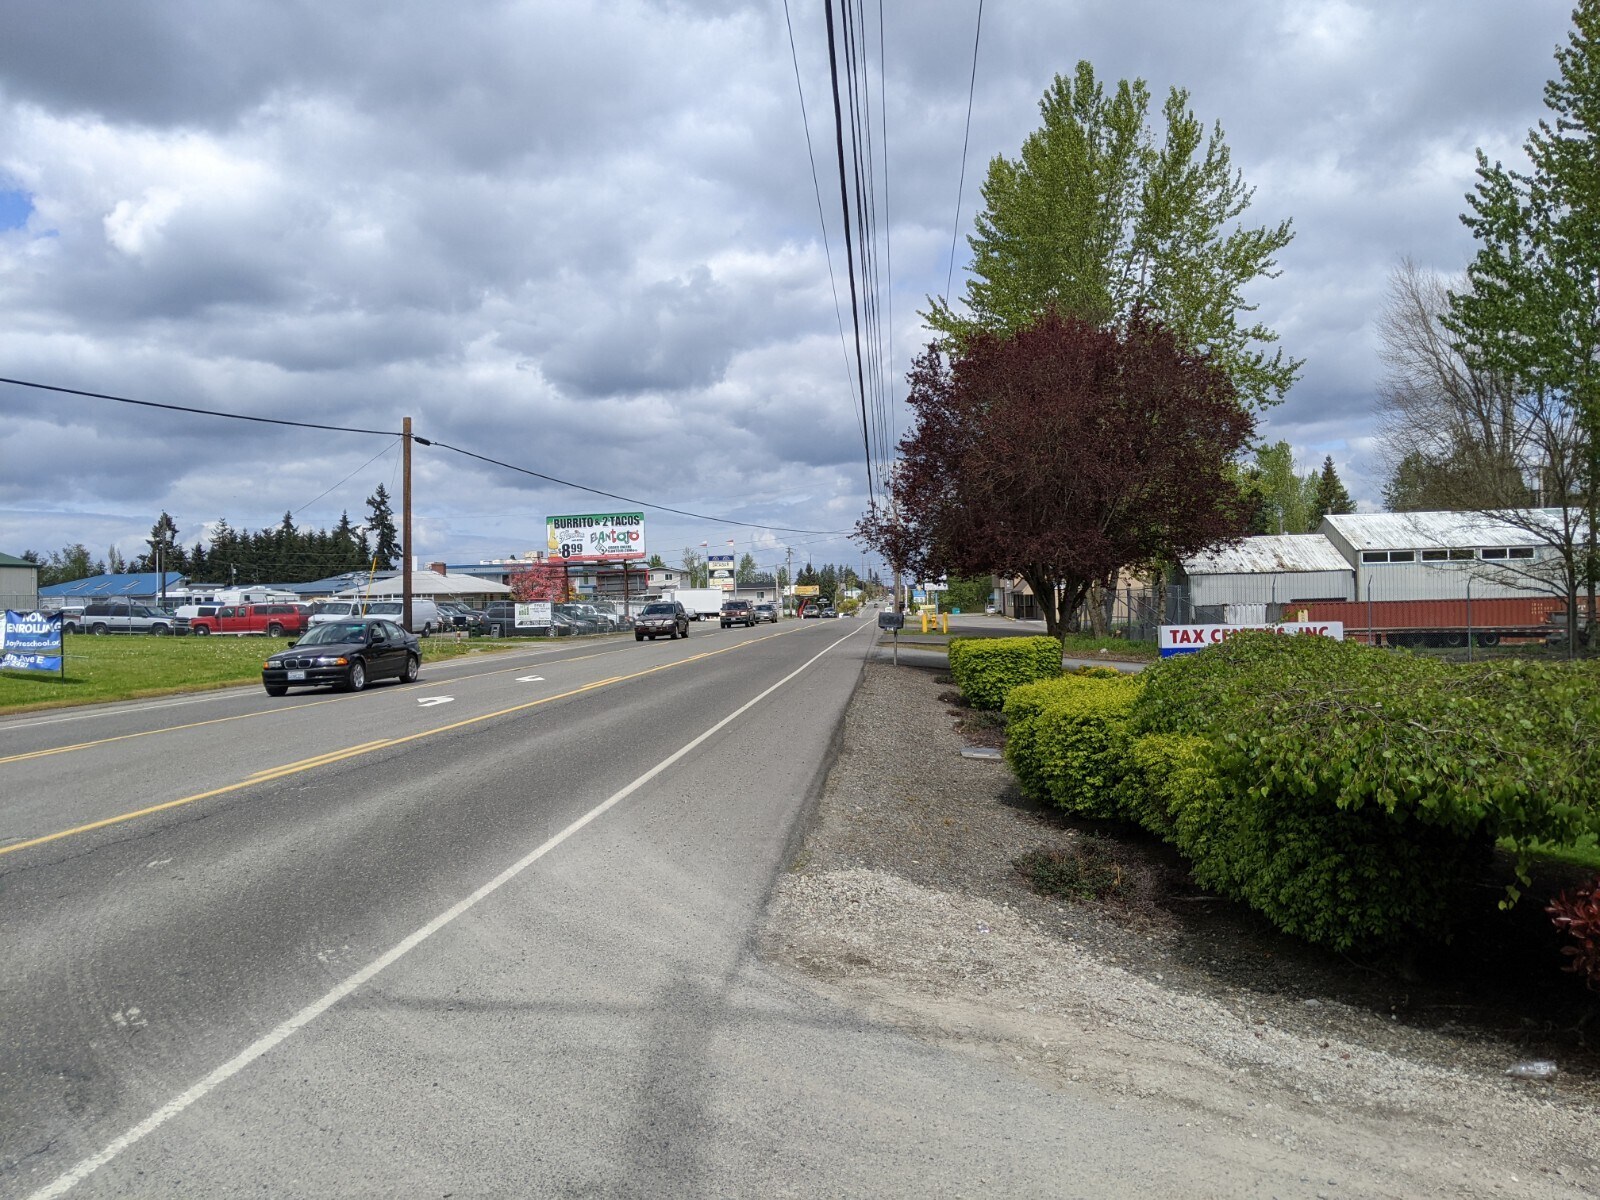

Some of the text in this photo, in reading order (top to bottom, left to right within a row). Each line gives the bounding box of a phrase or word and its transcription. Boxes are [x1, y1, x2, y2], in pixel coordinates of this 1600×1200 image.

[554, 517, 593, 529] BURRITO
[603, 516, 609, 526] 2
[610, 515, 640, 526] TACOS
[7, 622, 61, 633] ENROLLING
[1169, 629, 1205, 644] TAX
[5, 640, 60, 648] JoyPreschool.or
[19, 654, 35, 663] Ave
[36, 655, 45, 664] E
